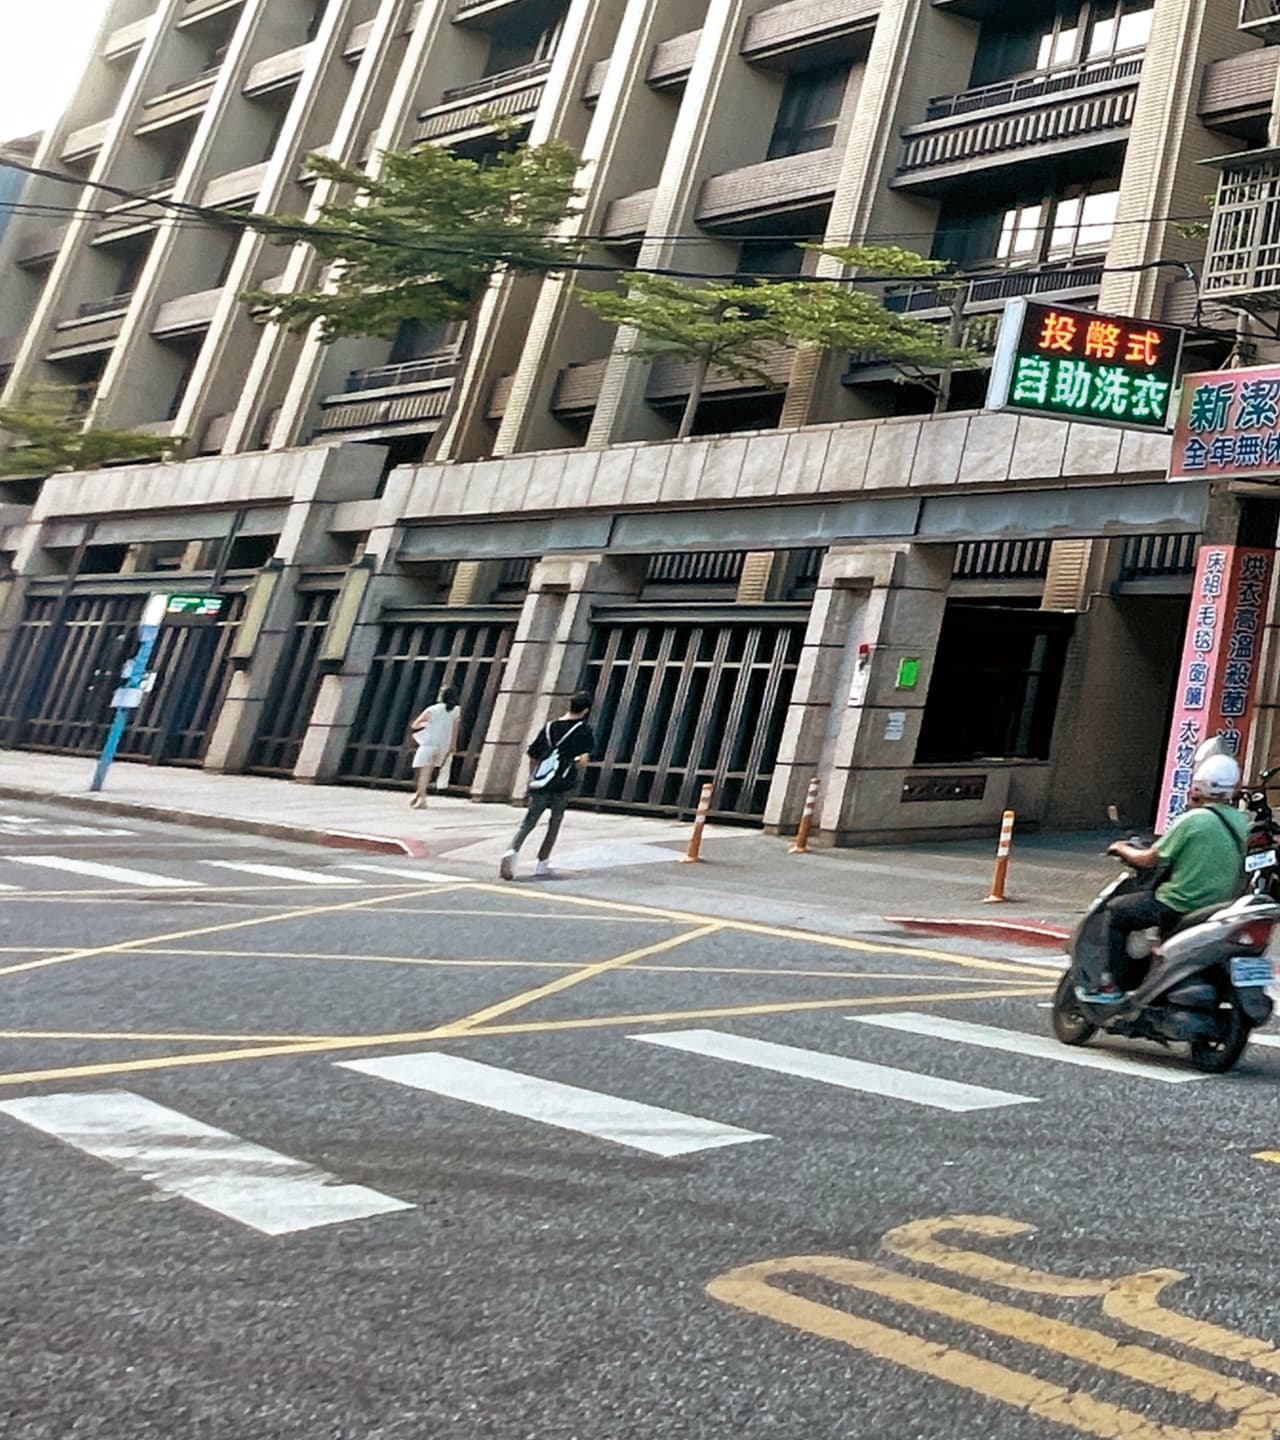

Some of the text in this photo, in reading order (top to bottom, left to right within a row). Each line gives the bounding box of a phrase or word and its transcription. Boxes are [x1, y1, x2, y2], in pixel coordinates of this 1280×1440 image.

[1039, 312, 1160, 366] 投幣式
[1013, 355, 1168, 419] 自助洗衣
